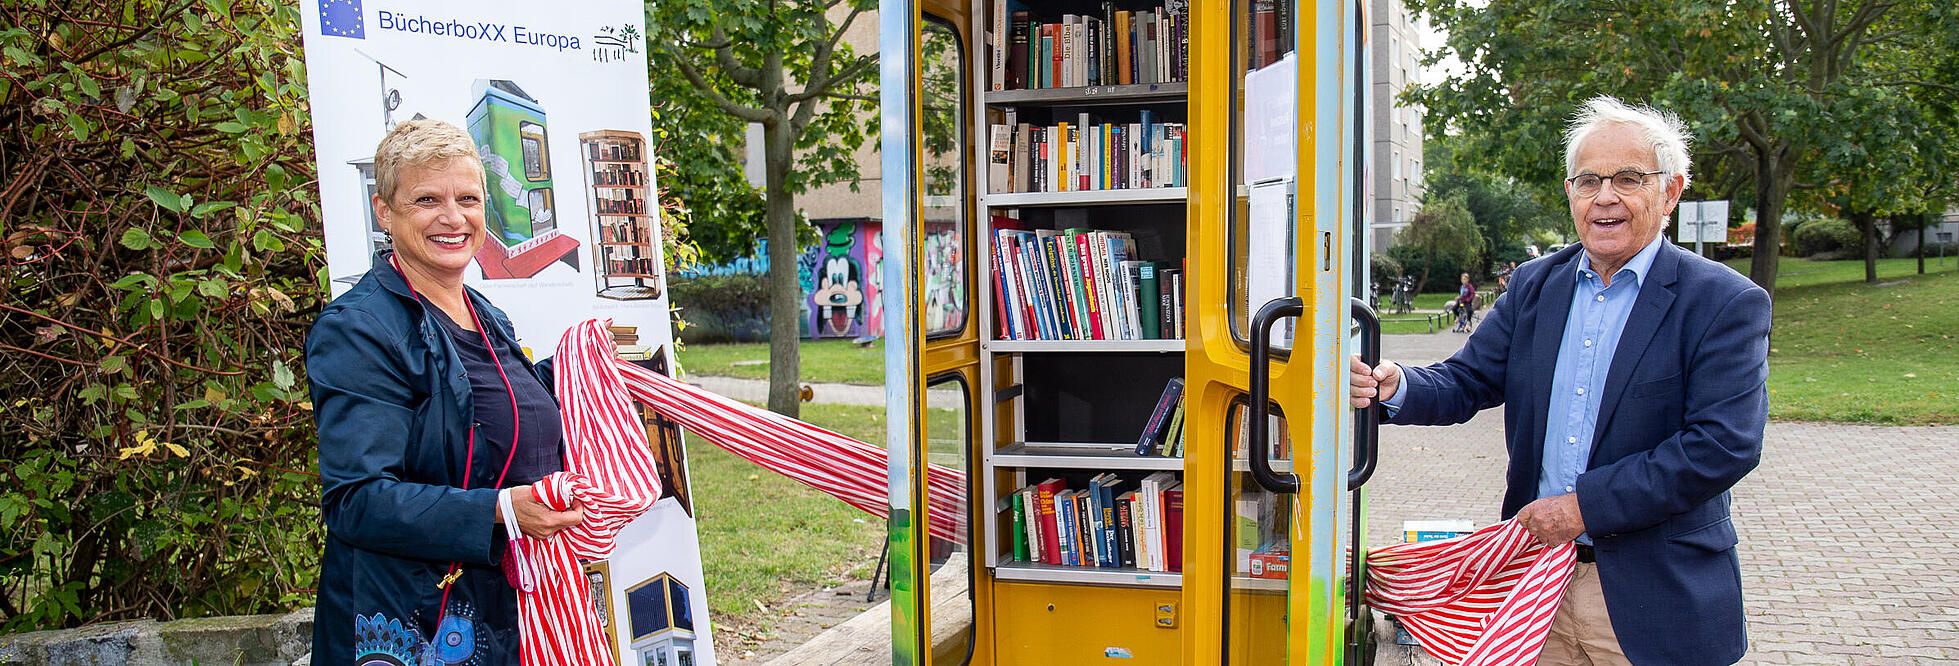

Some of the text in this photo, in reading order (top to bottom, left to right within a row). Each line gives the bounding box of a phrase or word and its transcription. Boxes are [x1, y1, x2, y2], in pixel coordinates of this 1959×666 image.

[379, 11, 581, 51] BücherboXX Europa
[1063, 23, 1071, 43] Bibel
[1084, 277, 1095, 313] Jugendbuch
[1266, 563, 1287, 572] Farm
